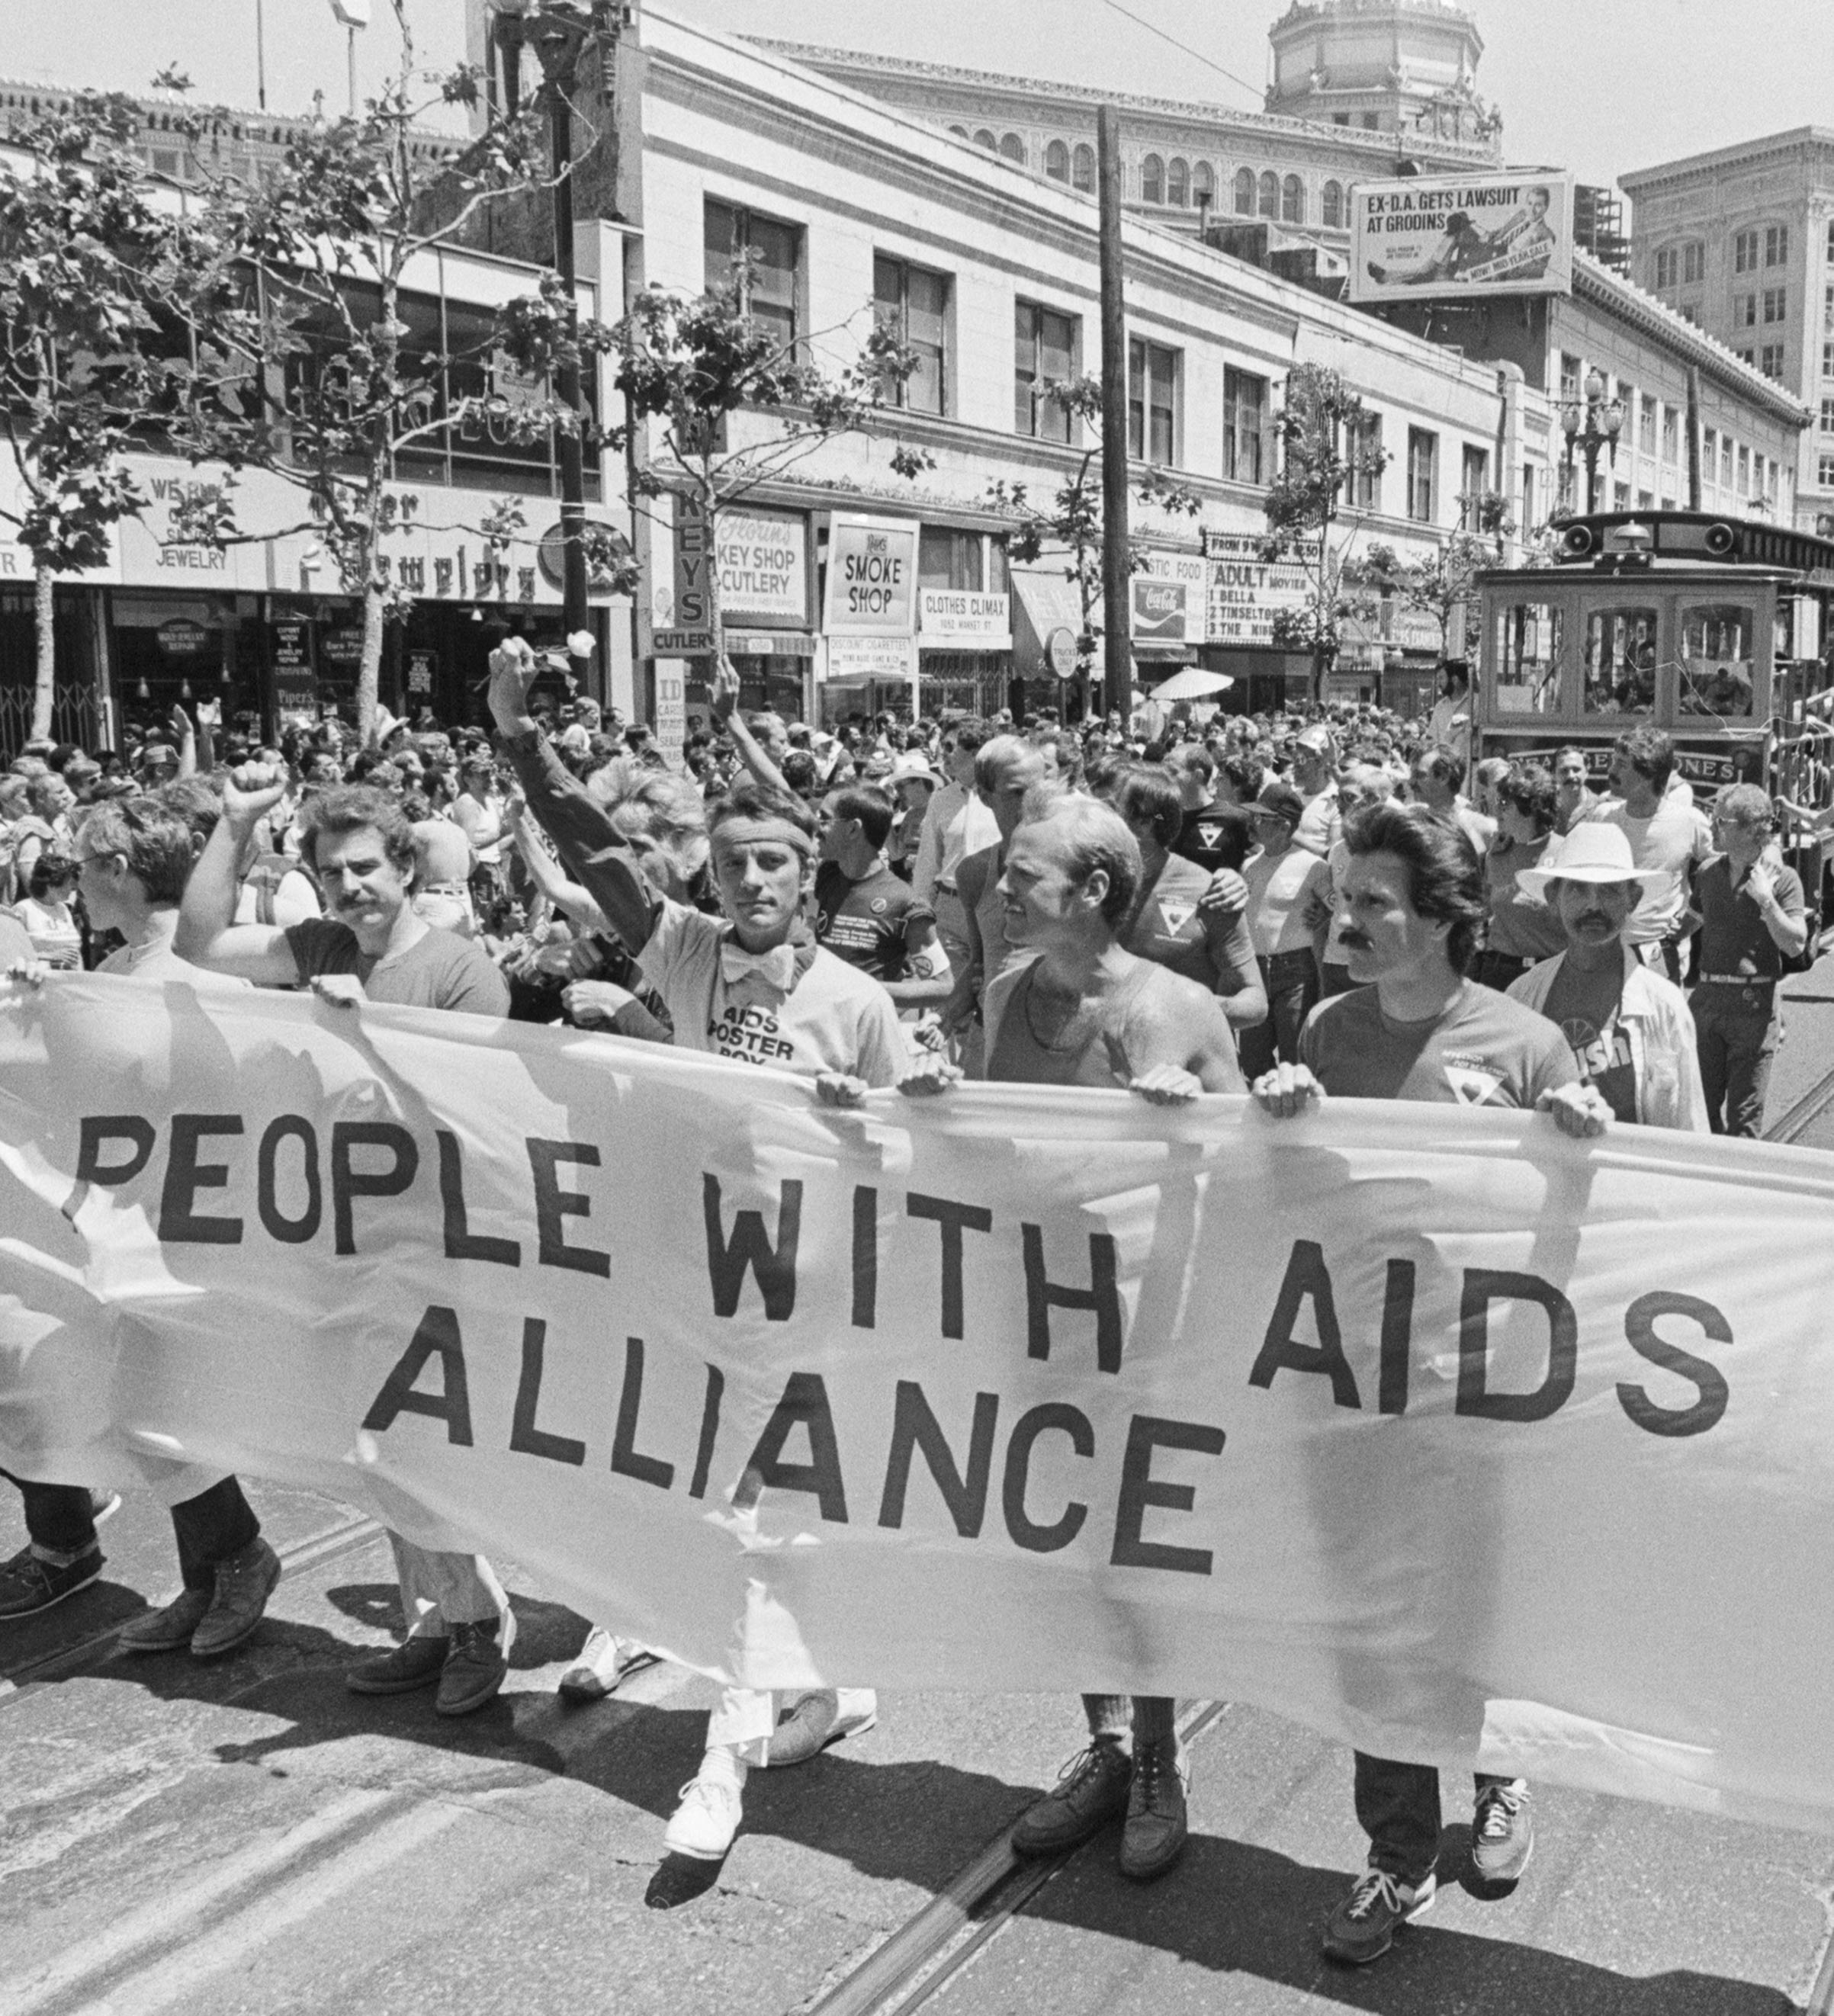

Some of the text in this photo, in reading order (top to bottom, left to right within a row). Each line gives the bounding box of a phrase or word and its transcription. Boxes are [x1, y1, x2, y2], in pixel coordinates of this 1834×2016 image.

[1367, 187, 1521, 214] EX-D.A. GETS LAWSUIT
[1367, 212, 1446, 233] AT GRODINS
[1527, 242, 1548, 257] SALE
[679, 489, 704, 622] KEYS
[1212, 538, 1240, 551] FROM
[156, 549, 226, 570] JEWELRY
[717, 544, 795, 571] KEY SHOP
[845, 554, 901, 584] SMOKE
[1142, 558, 1201, 580] STIC FOOD
[721, 569, 790, 595] CUTLERY
[1214, 565, 1268, 588] ADULT
[849, 586, 892, 614] SHOP
[926, 595, 1004, 617] CLOTHES CLIMAX
[1220, 590, 1256, 603] BELLA
[1209, 606, 1216, 619] 2
[1209, 622, 1216, 635] 3
[1220, 623, 1241, 636] THE
[278, 689, 314, 708] Piper's
[723, 1006, 779, 1034] AIDS
[706, 1019, 795, 1061] POSTER
[61, 1114, 1734, 1438] PEOPLE WITH AIDS
[361, 1305, 1226, 1576] ALLIANCE
